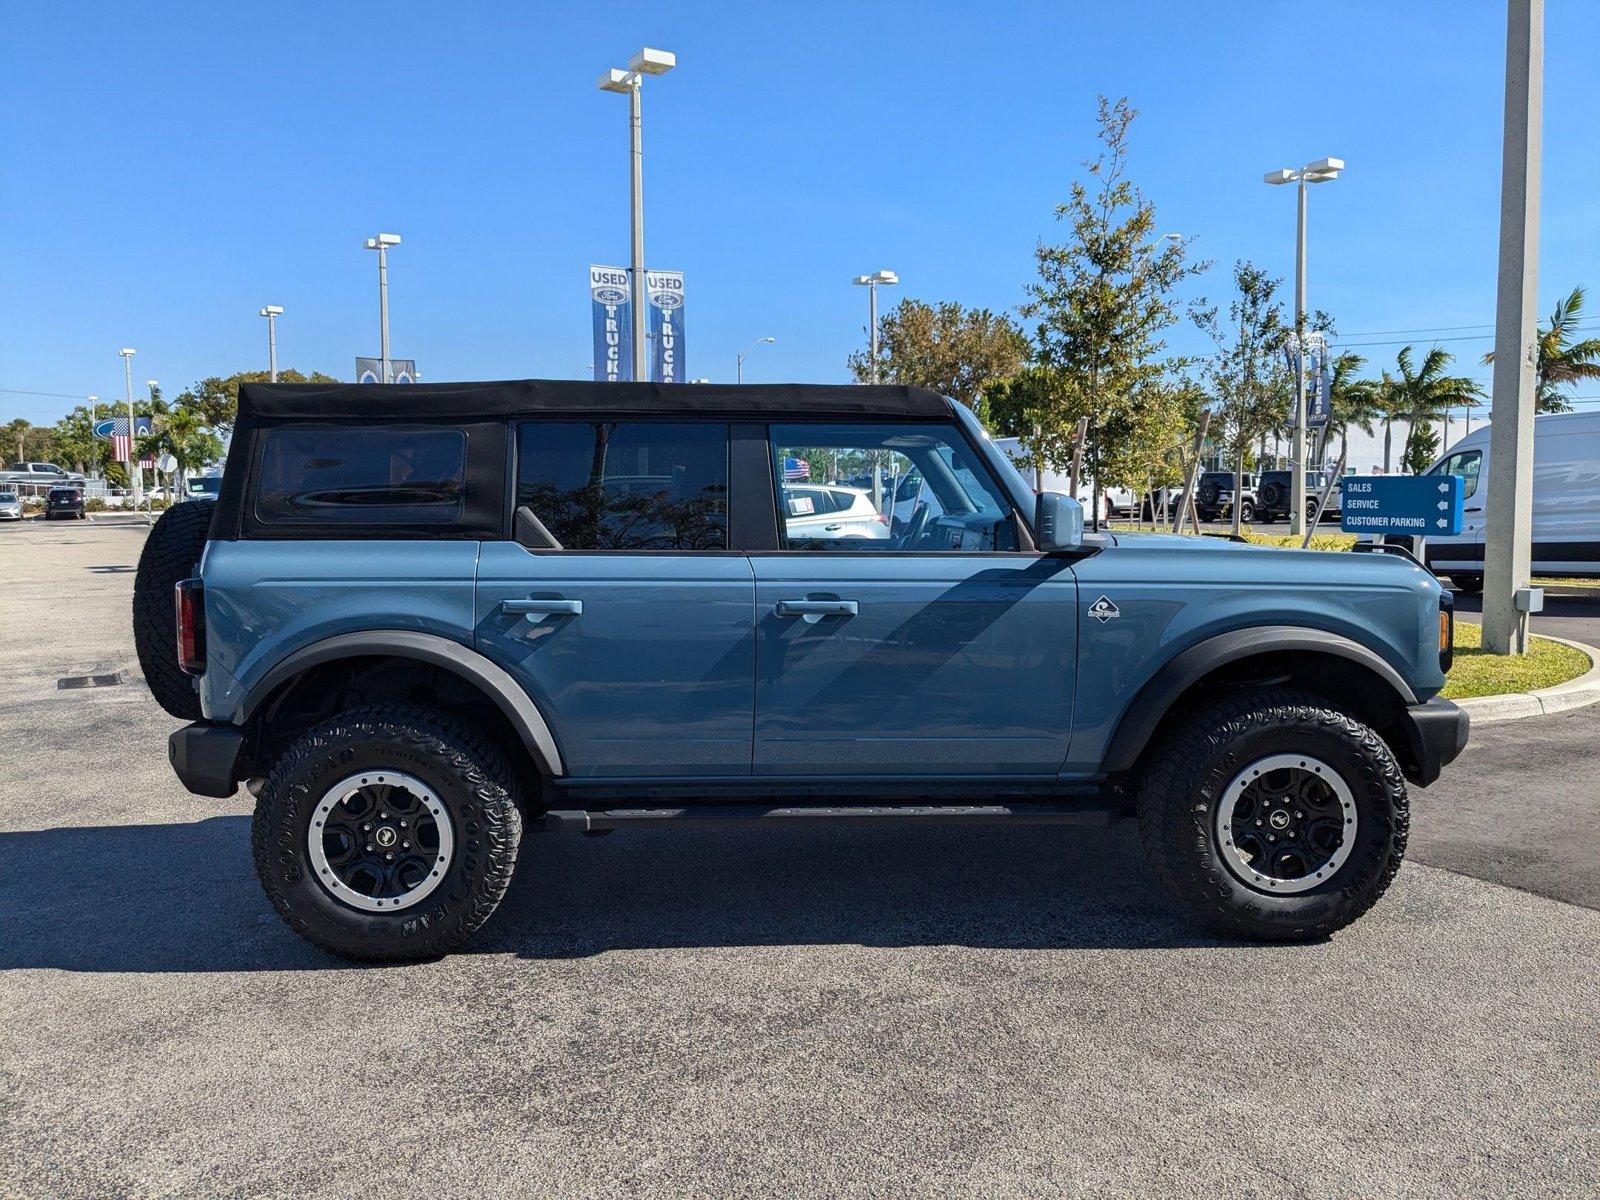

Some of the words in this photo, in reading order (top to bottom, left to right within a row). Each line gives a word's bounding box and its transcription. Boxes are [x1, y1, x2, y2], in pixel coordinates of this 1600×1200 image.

[592, 271, 628, 286] USED
[648, 276, 683, 290] USED
[601, 291, 619, 300] Ford
[1347, 483, 1372, 493] SALES
[1347, 500, 1379, 509] SERVICE
[1346, 516, 1389, 526] CUSTOMER
[1390, 518, 1425, 527] PARKING
